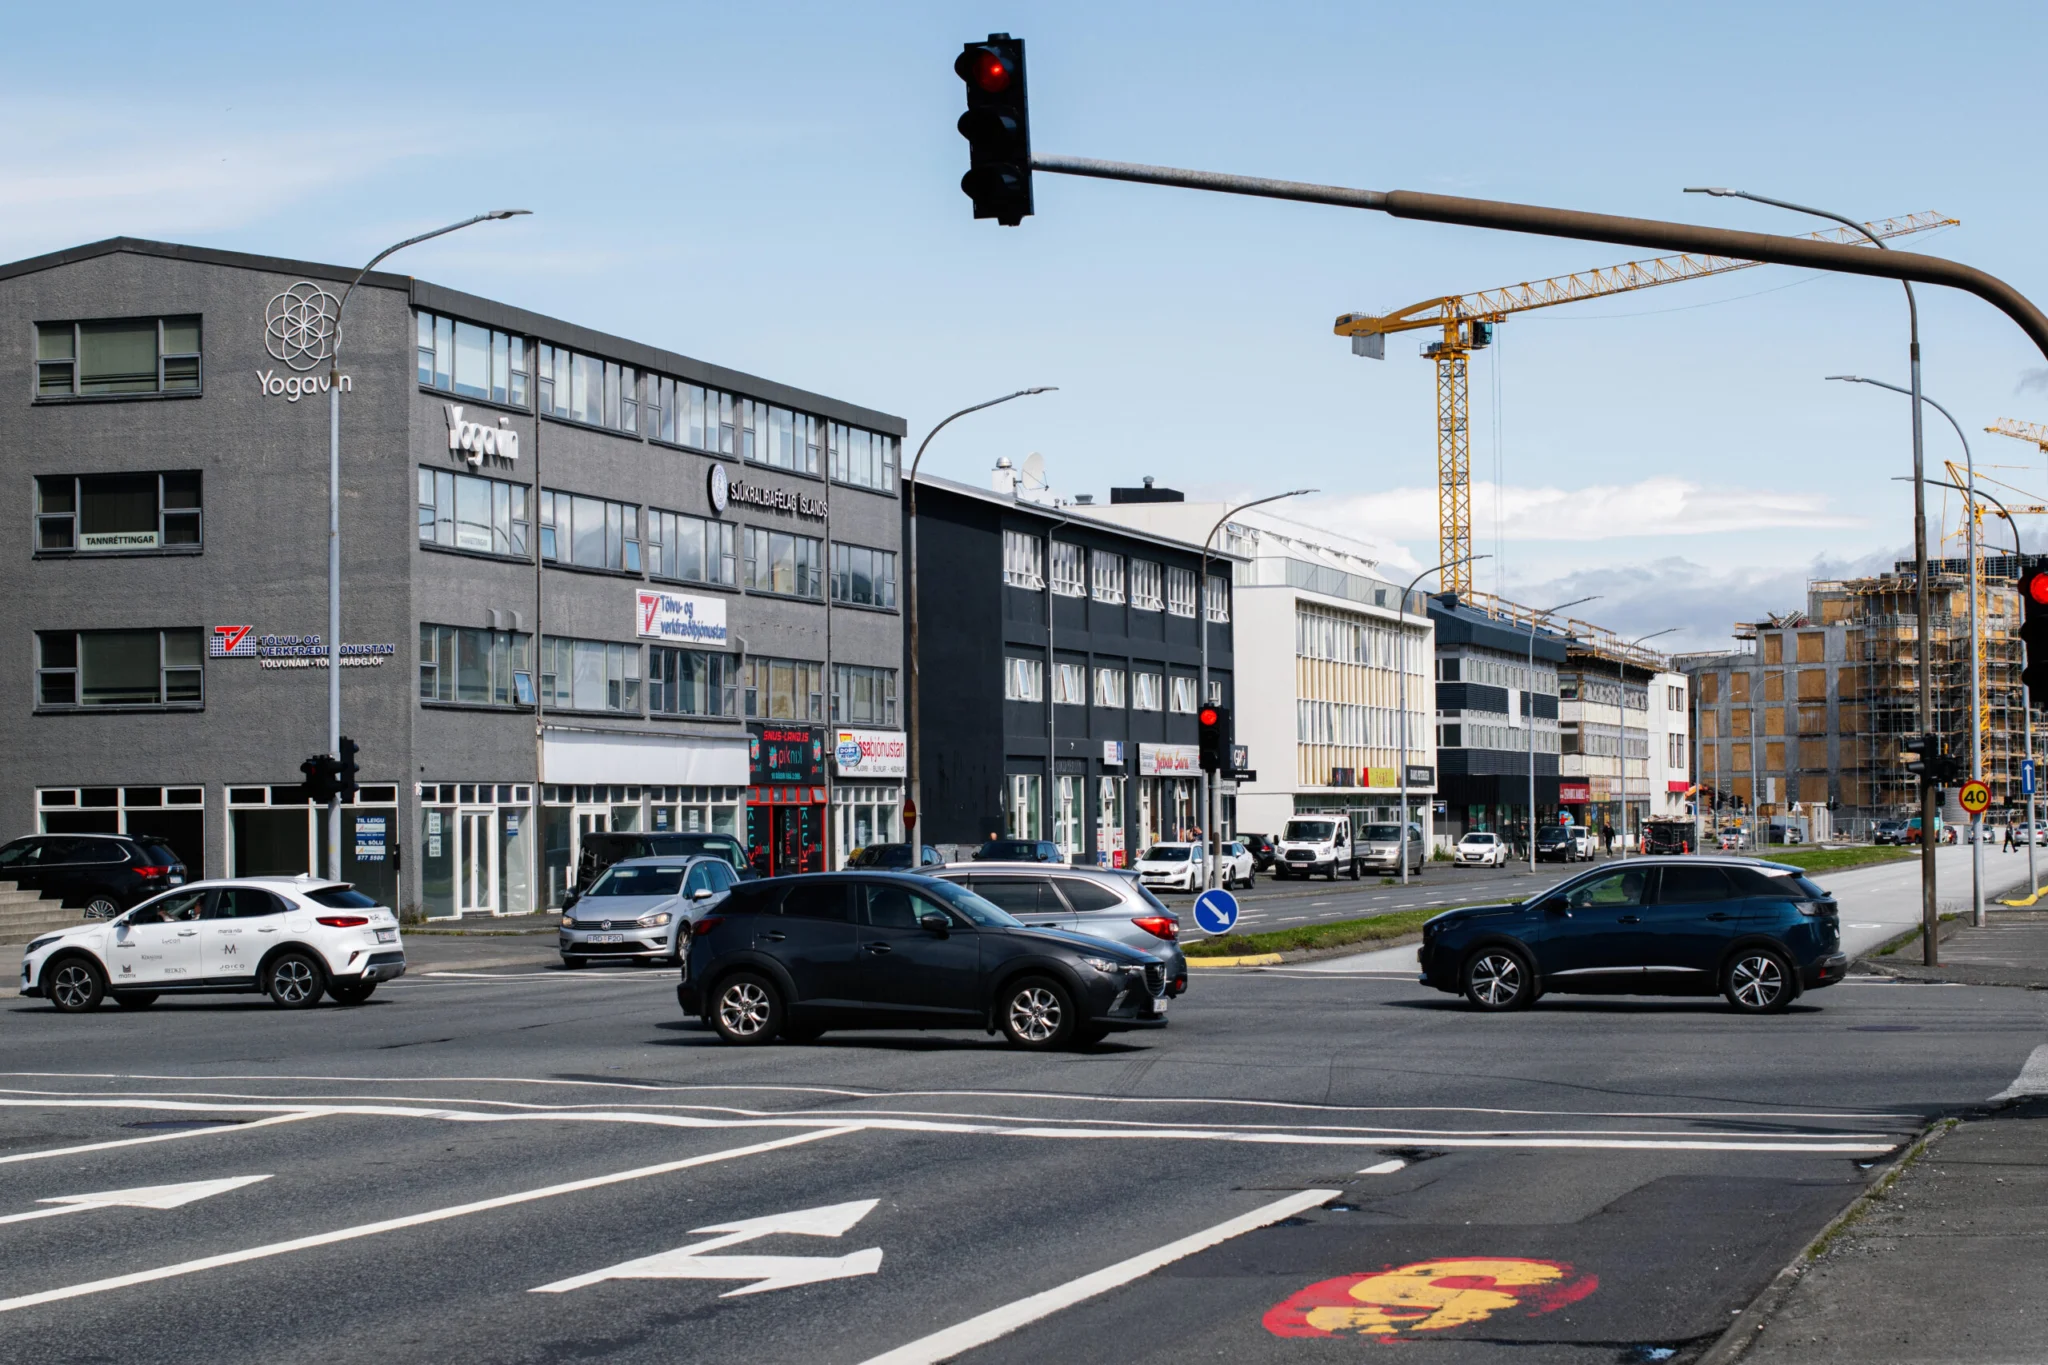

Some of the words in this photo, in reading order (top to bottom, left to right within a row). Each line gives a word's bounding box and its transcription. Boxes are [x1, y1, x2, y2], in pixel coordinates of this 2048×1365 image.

[256, 370, 352, 402] Yogavn
[444, 404, 519, 467] Yogavin
[799, 493, 828, 518] ÍSLANDS
[85, 535, 155, 546] TANNRÉTTINGAR
[684, 602, 694, 619] og
[304, 635, 320, 644] OG
[260, 644, 395, 656] VERKFRÆÐIÓNUSTAN
[260, 657, 309, 668] TÖLVUNÁM
[1963, 790, 1988, 805] 40
